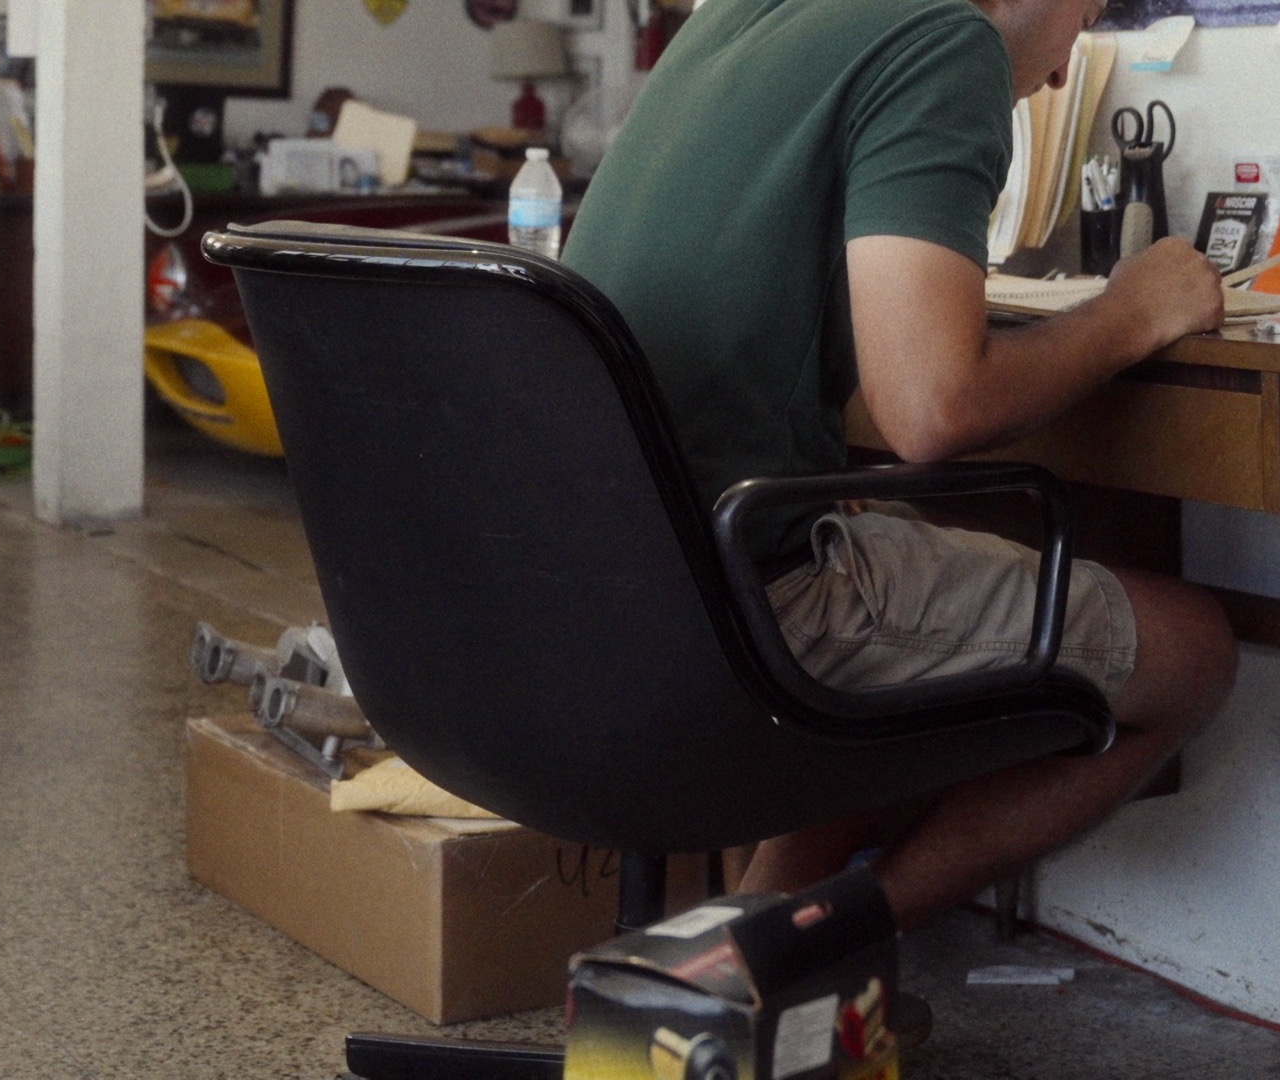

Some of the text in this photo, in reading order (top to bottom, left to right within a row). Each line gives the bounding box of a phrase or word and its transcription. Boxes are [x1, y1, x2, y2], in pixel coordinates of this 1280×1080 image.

[1224, 197, 1258, 209] NASCAR
[1214, 227, 1240, 235] ROLEX
[1210, 238, 1237, 251] 24
